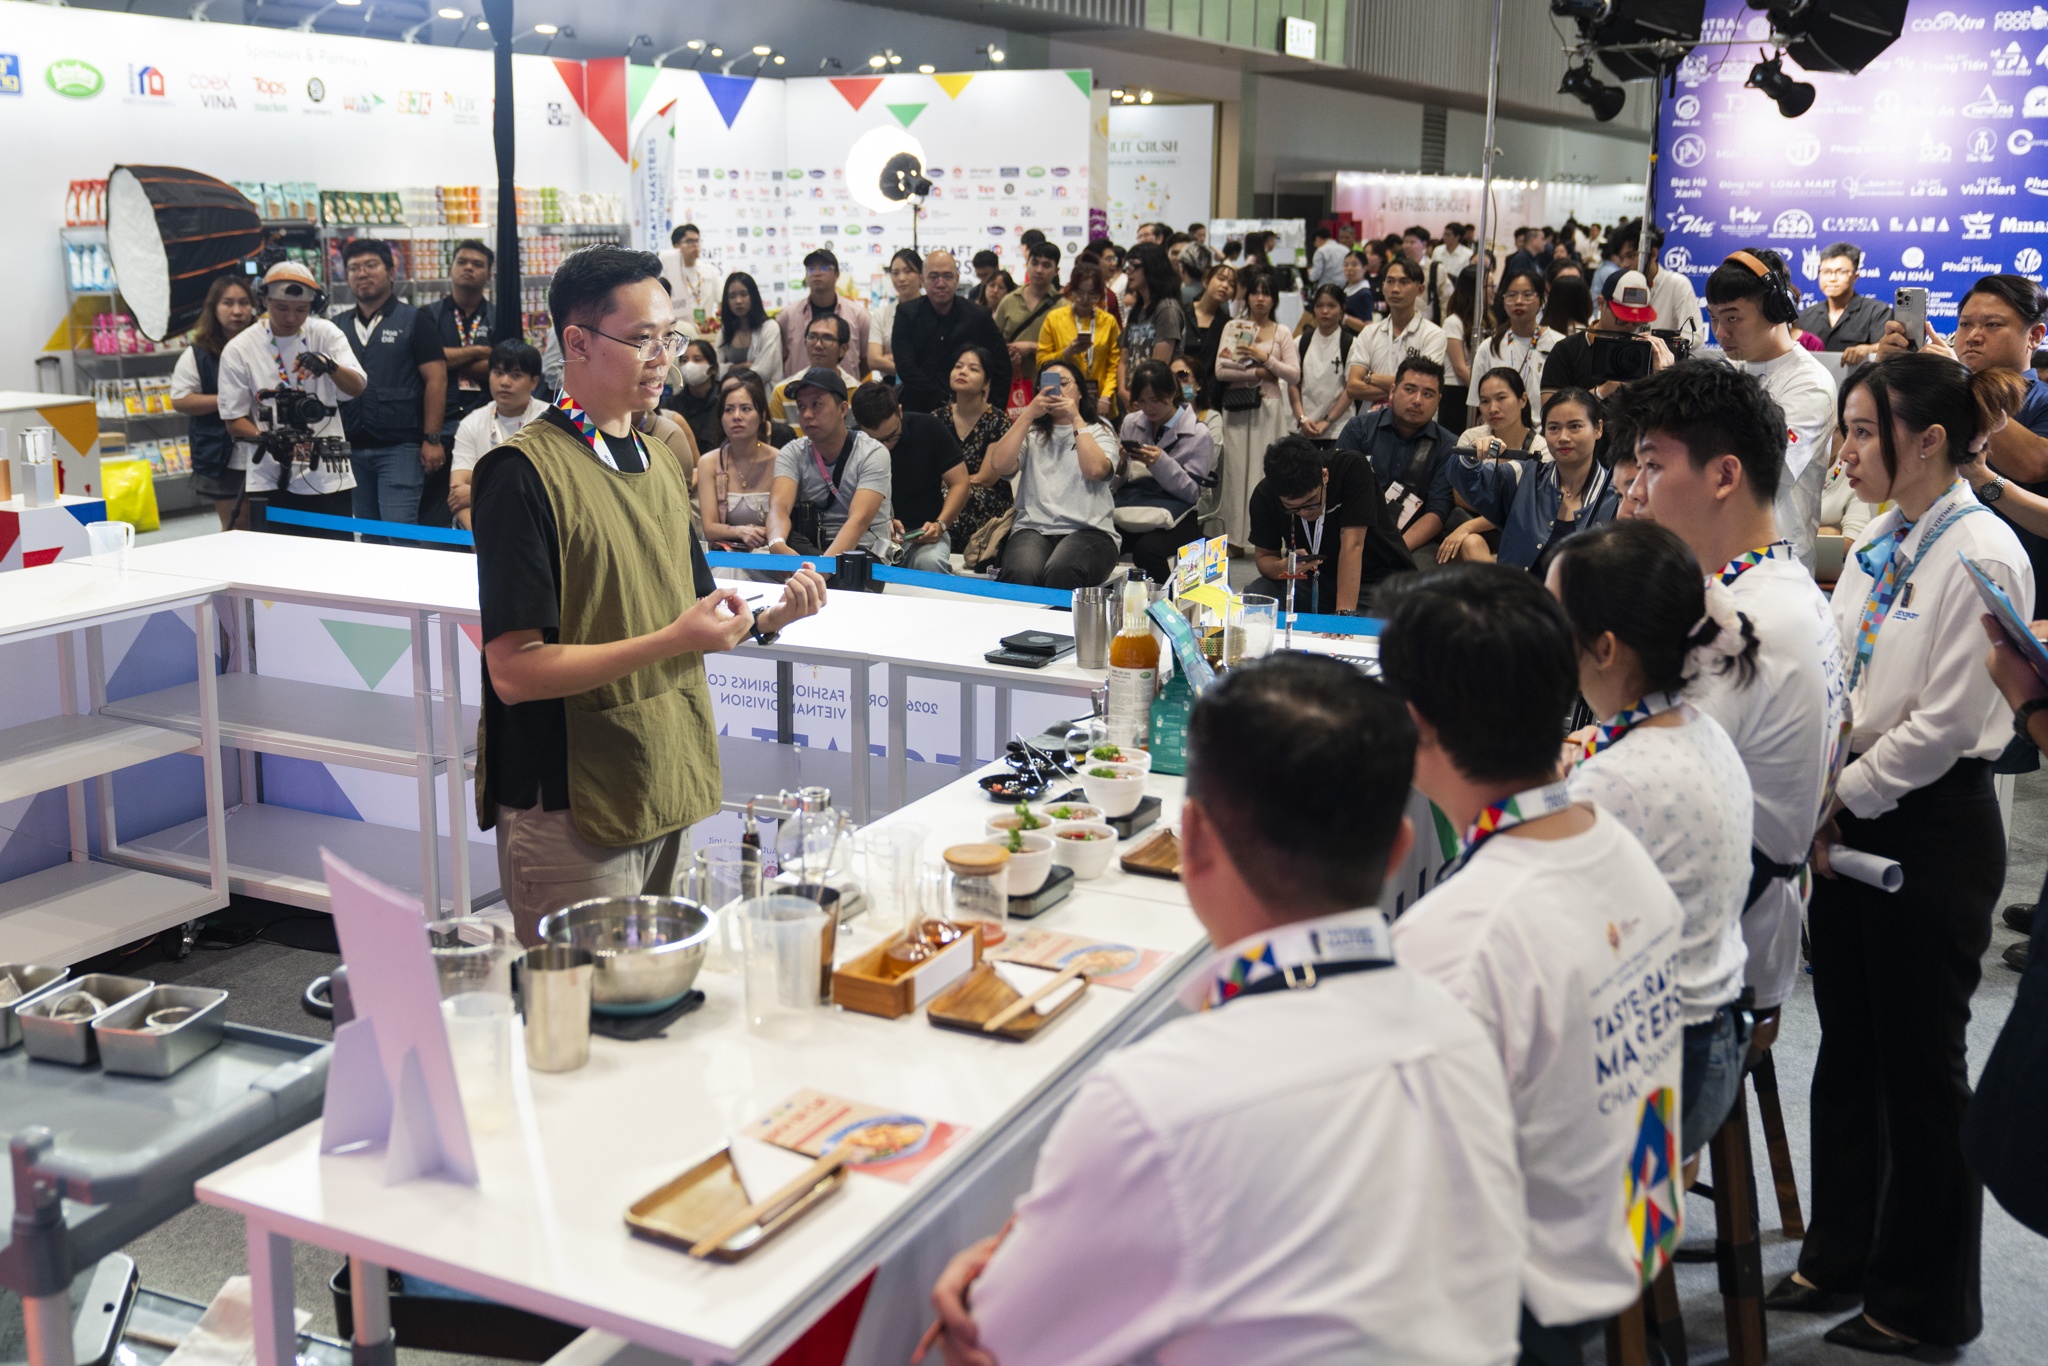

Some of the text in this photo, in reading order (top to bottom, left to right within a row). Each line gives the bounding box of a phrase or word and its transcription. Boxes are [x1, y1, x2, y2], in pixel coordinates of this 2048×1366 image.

[1701, 18, 1744, 30] NTRAL
[253, 76, 287, 99] Tops
[200, 93, 238, 111] VINA
[1136, 139, 1179, 154] CRUSH
[1933, 502, 1957, 527] VIETNAM
